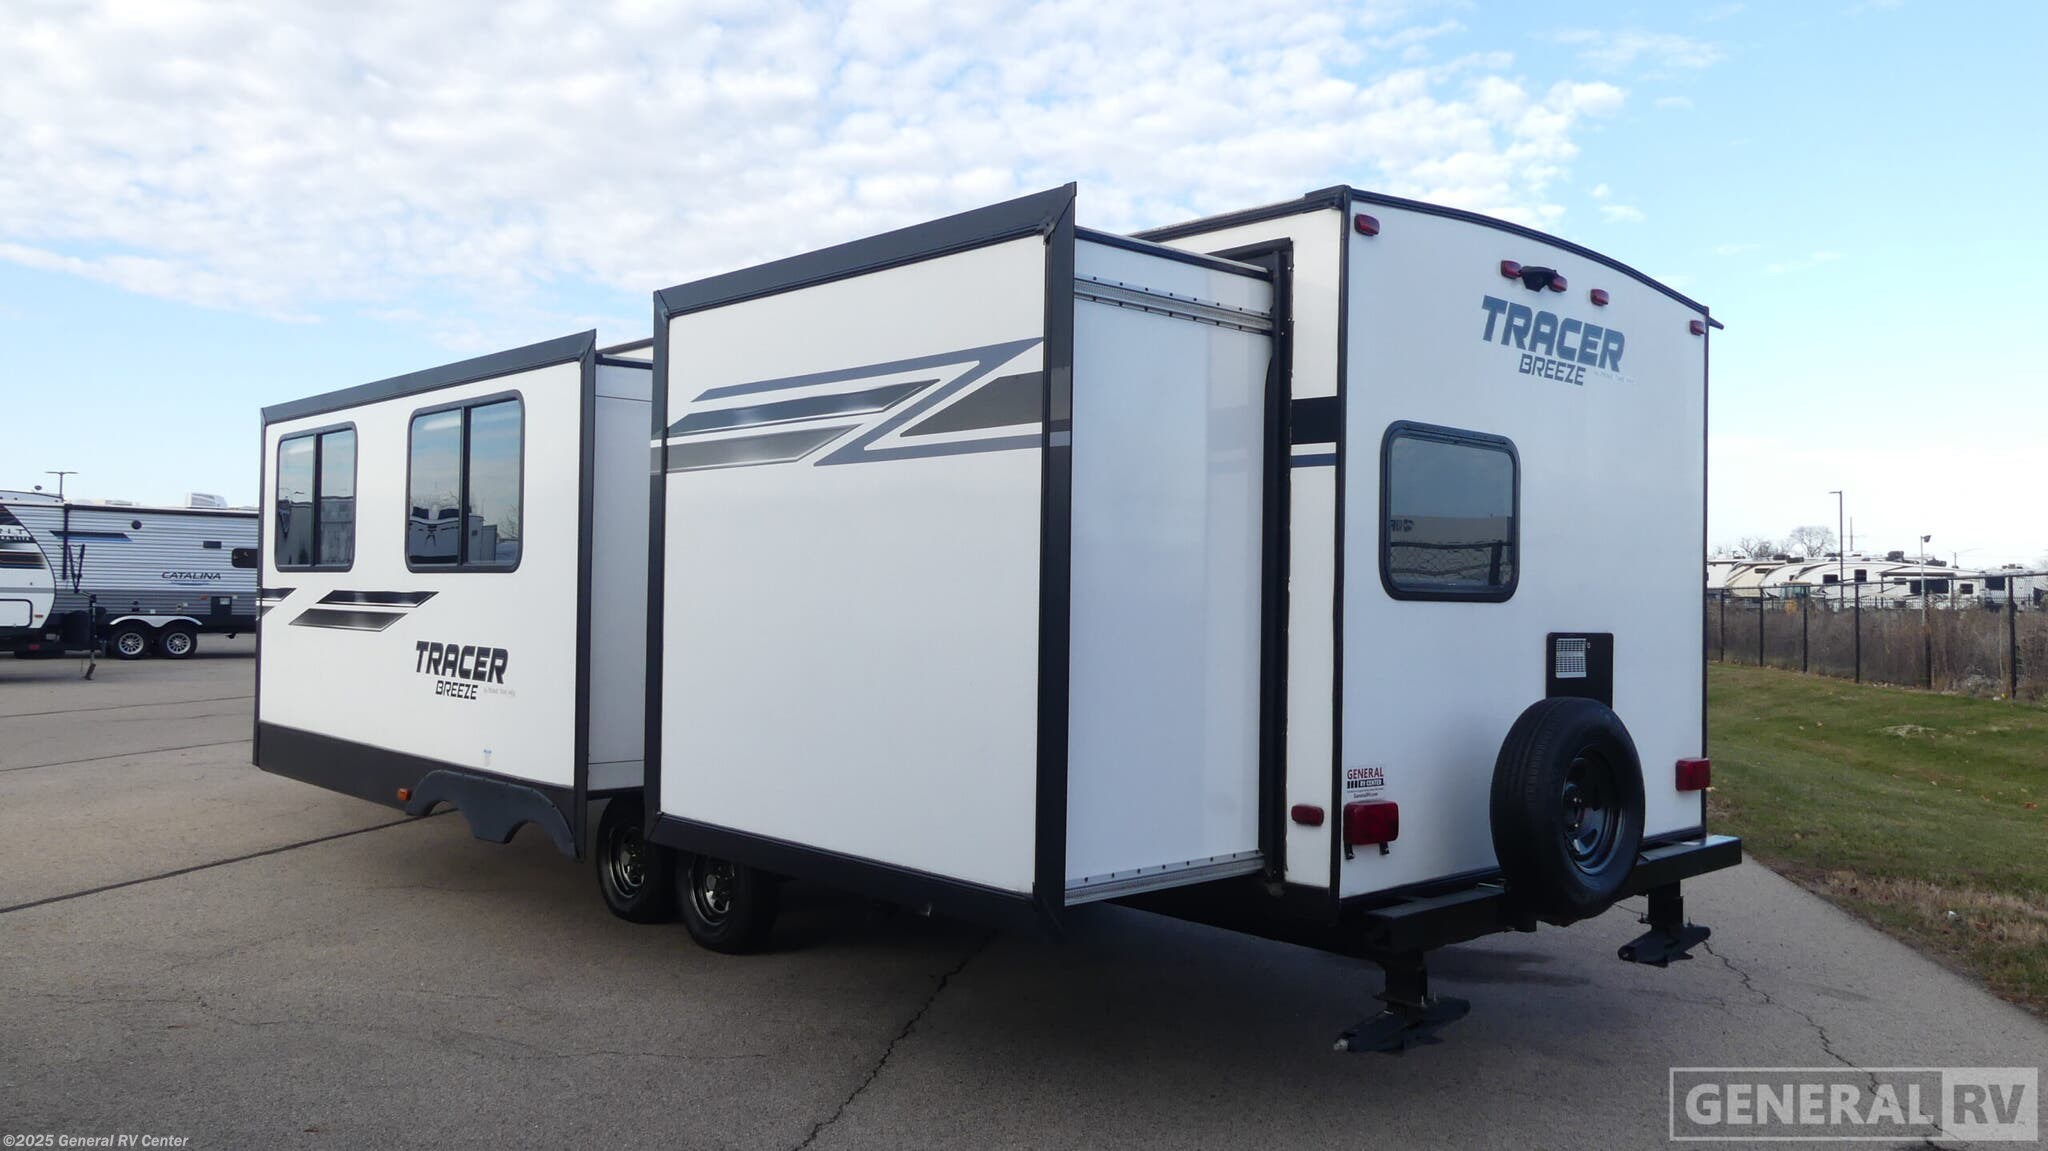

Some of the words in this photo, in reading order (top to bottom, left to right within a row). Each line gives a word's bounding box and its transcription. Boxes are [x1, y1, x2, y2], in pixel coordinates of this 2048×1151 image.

[1482, 295, 1626, 372] TRACER
[1518, 353, 1587, 386] BREEZE
[161, 571, 222, 581] CATALINA
[416, 640, 509, 684] TRACER
[435, 680, 479, 700] BREEZE
[1347, 767, 1384, 780] GENERAL
